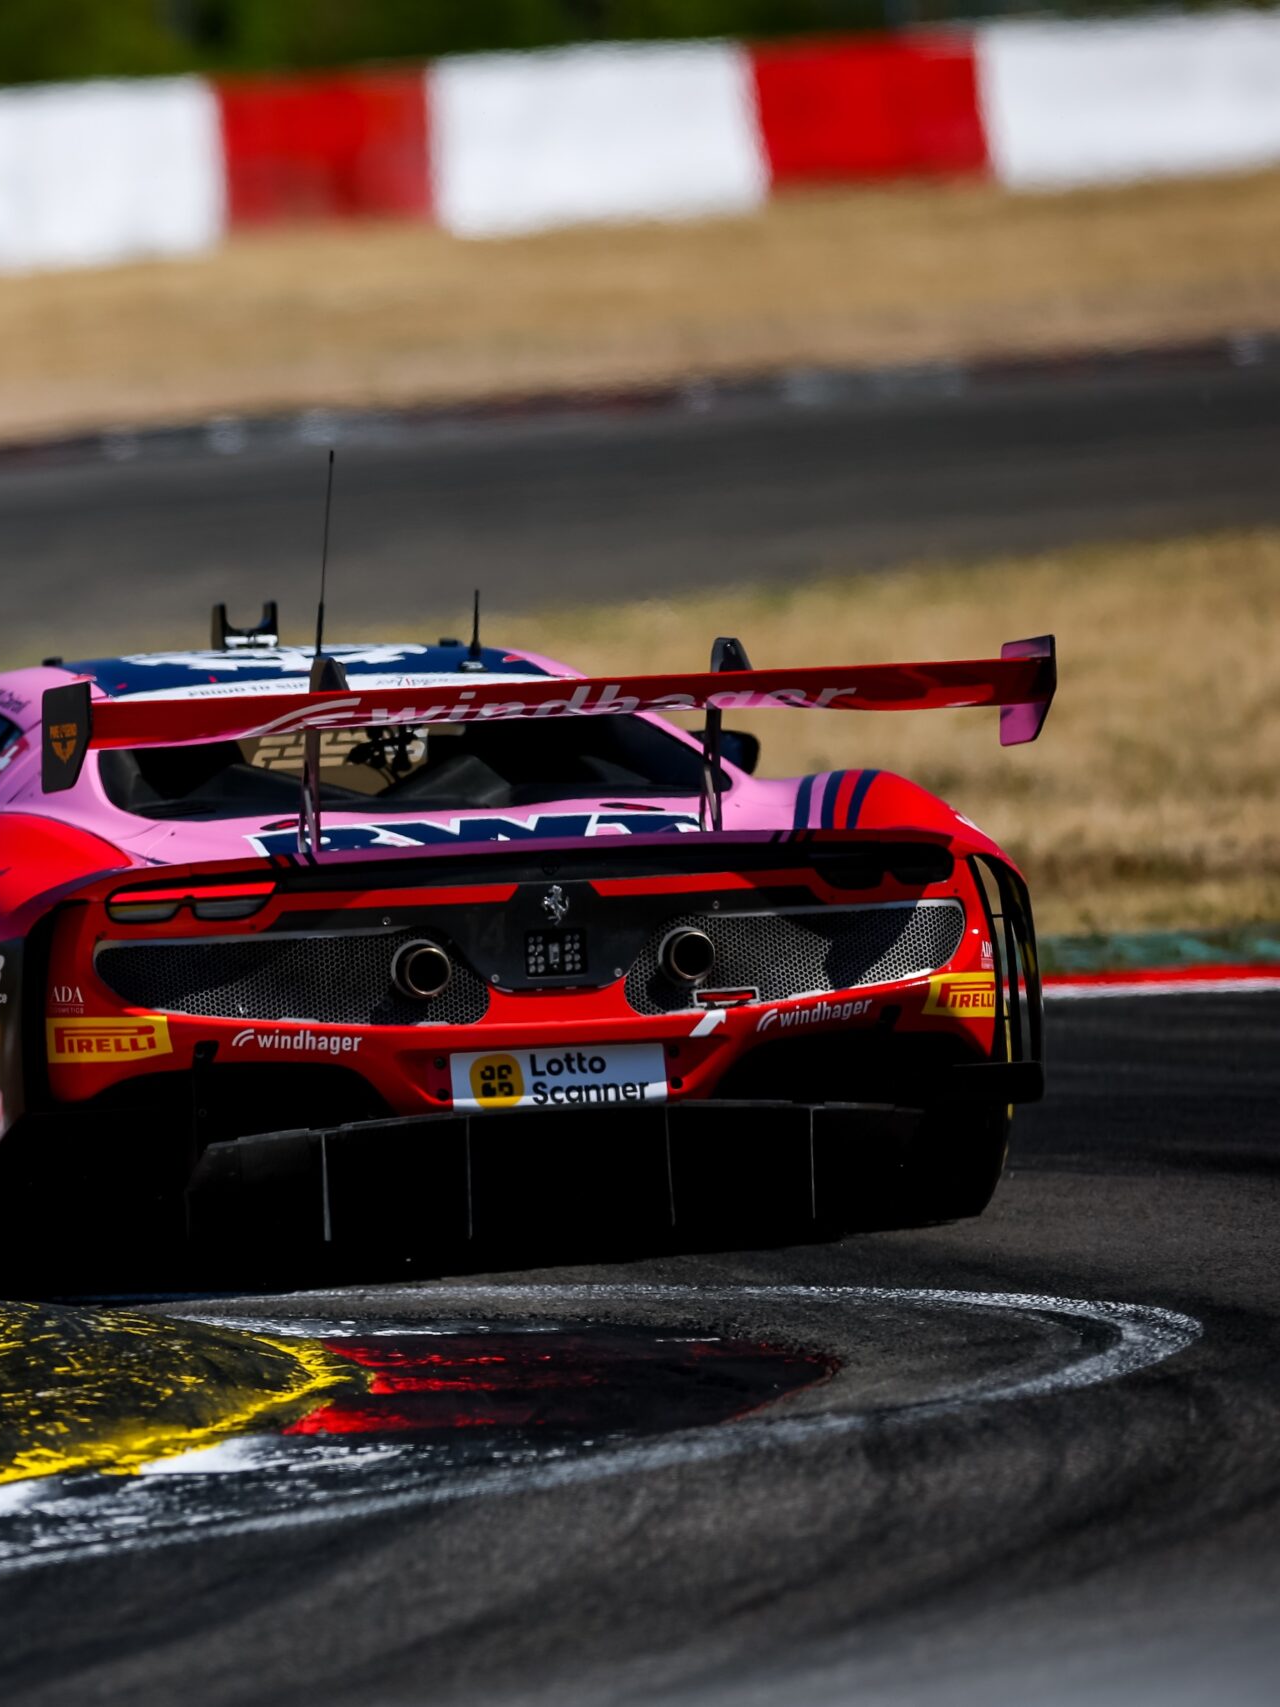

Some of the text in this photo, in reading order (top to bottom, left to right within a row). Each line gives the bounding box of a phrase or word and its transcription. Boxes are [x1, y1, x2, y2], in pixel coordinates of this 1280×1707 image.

[49, 985, 85, 1004] ADA
[779, 999, 873, 1029] windhager
[54, 1025, 157, 1054] PIRELLI
[257, 1030, 363, 1056] windhager
[529, 1052, 607, 1077] Lotto
[532, 1081, 649, 1105] Scanner
